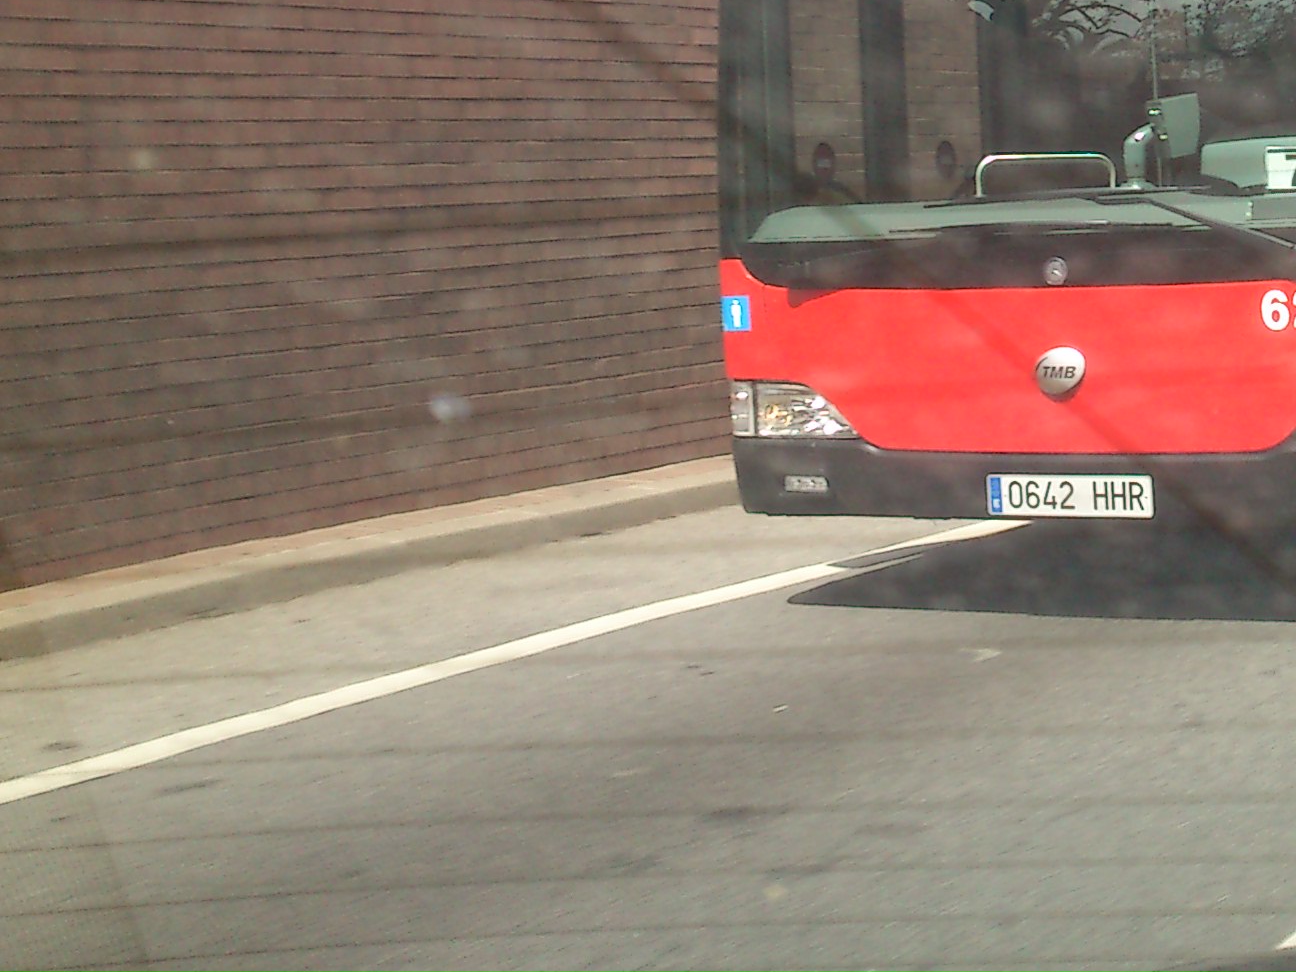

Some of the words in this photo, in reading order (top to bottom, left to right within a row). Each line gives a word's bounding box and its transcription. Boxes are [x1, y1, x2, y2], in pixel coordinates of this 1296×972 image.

[1042, 365, 1077, 379] TMB
[1008, 480, 1076, 510] 0642
[1092, 481, 1145, 511] HHR
